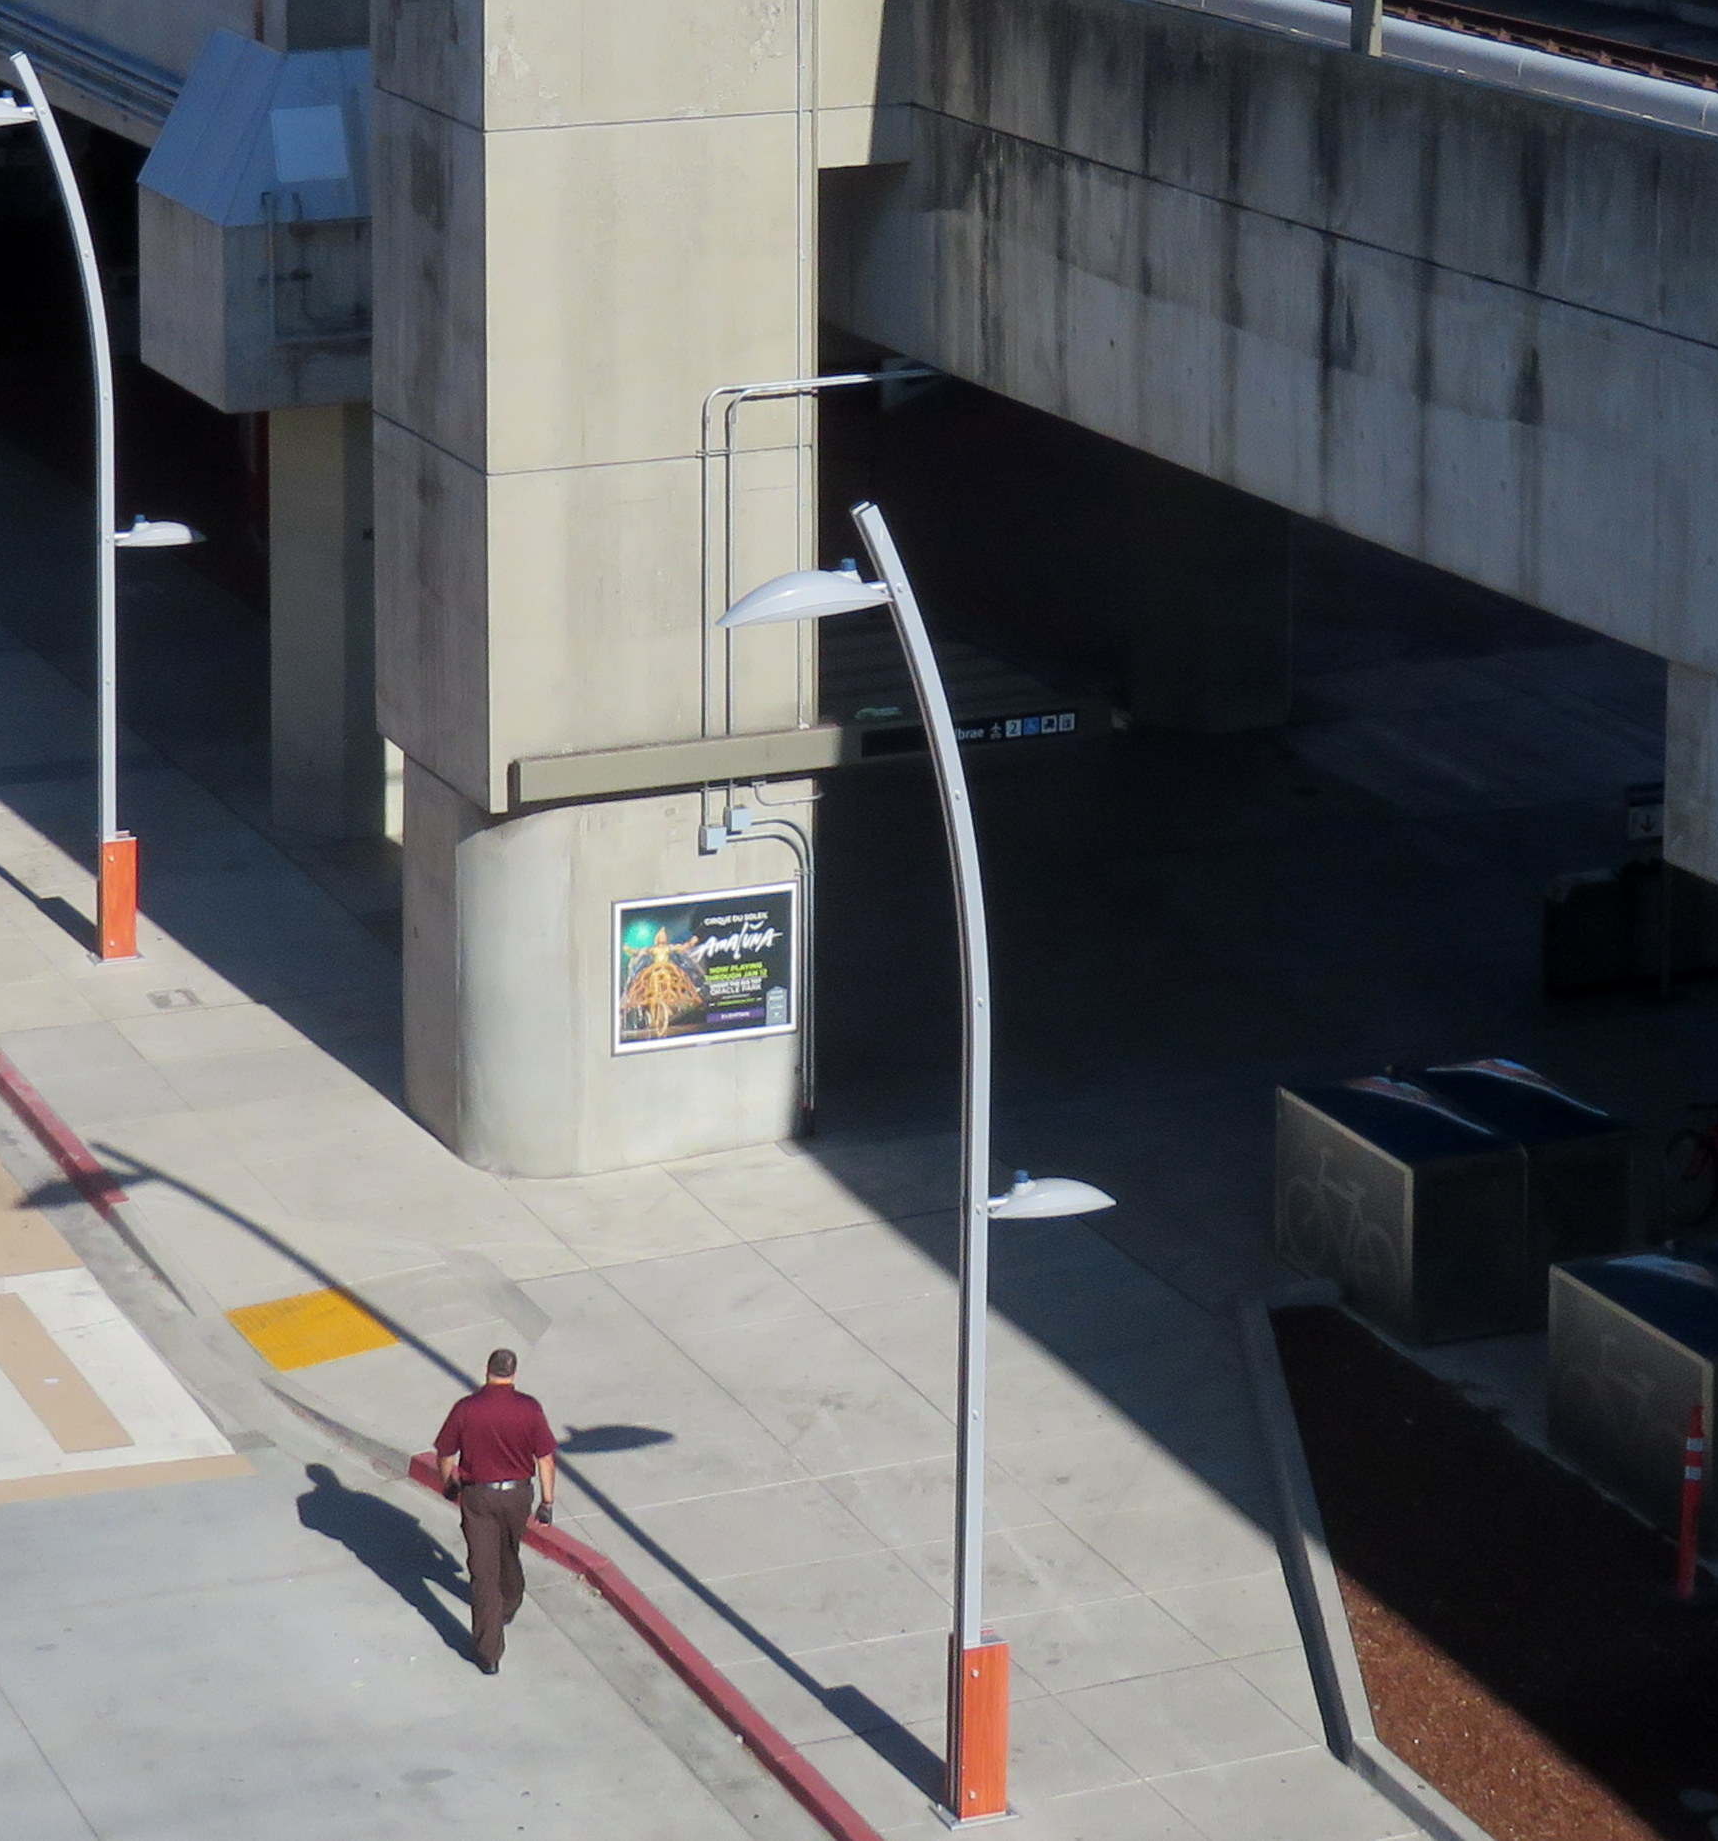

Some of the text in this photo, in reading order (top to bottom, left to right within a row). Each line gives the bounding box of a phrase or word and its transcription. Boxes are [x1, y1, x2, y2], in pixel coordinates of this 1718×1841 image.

[704, 911, 769, 927] CIRQUE DU SOLEIL
[710, 984, 740, 997] ORACLE
[741, 982, 762, 993] PARK
